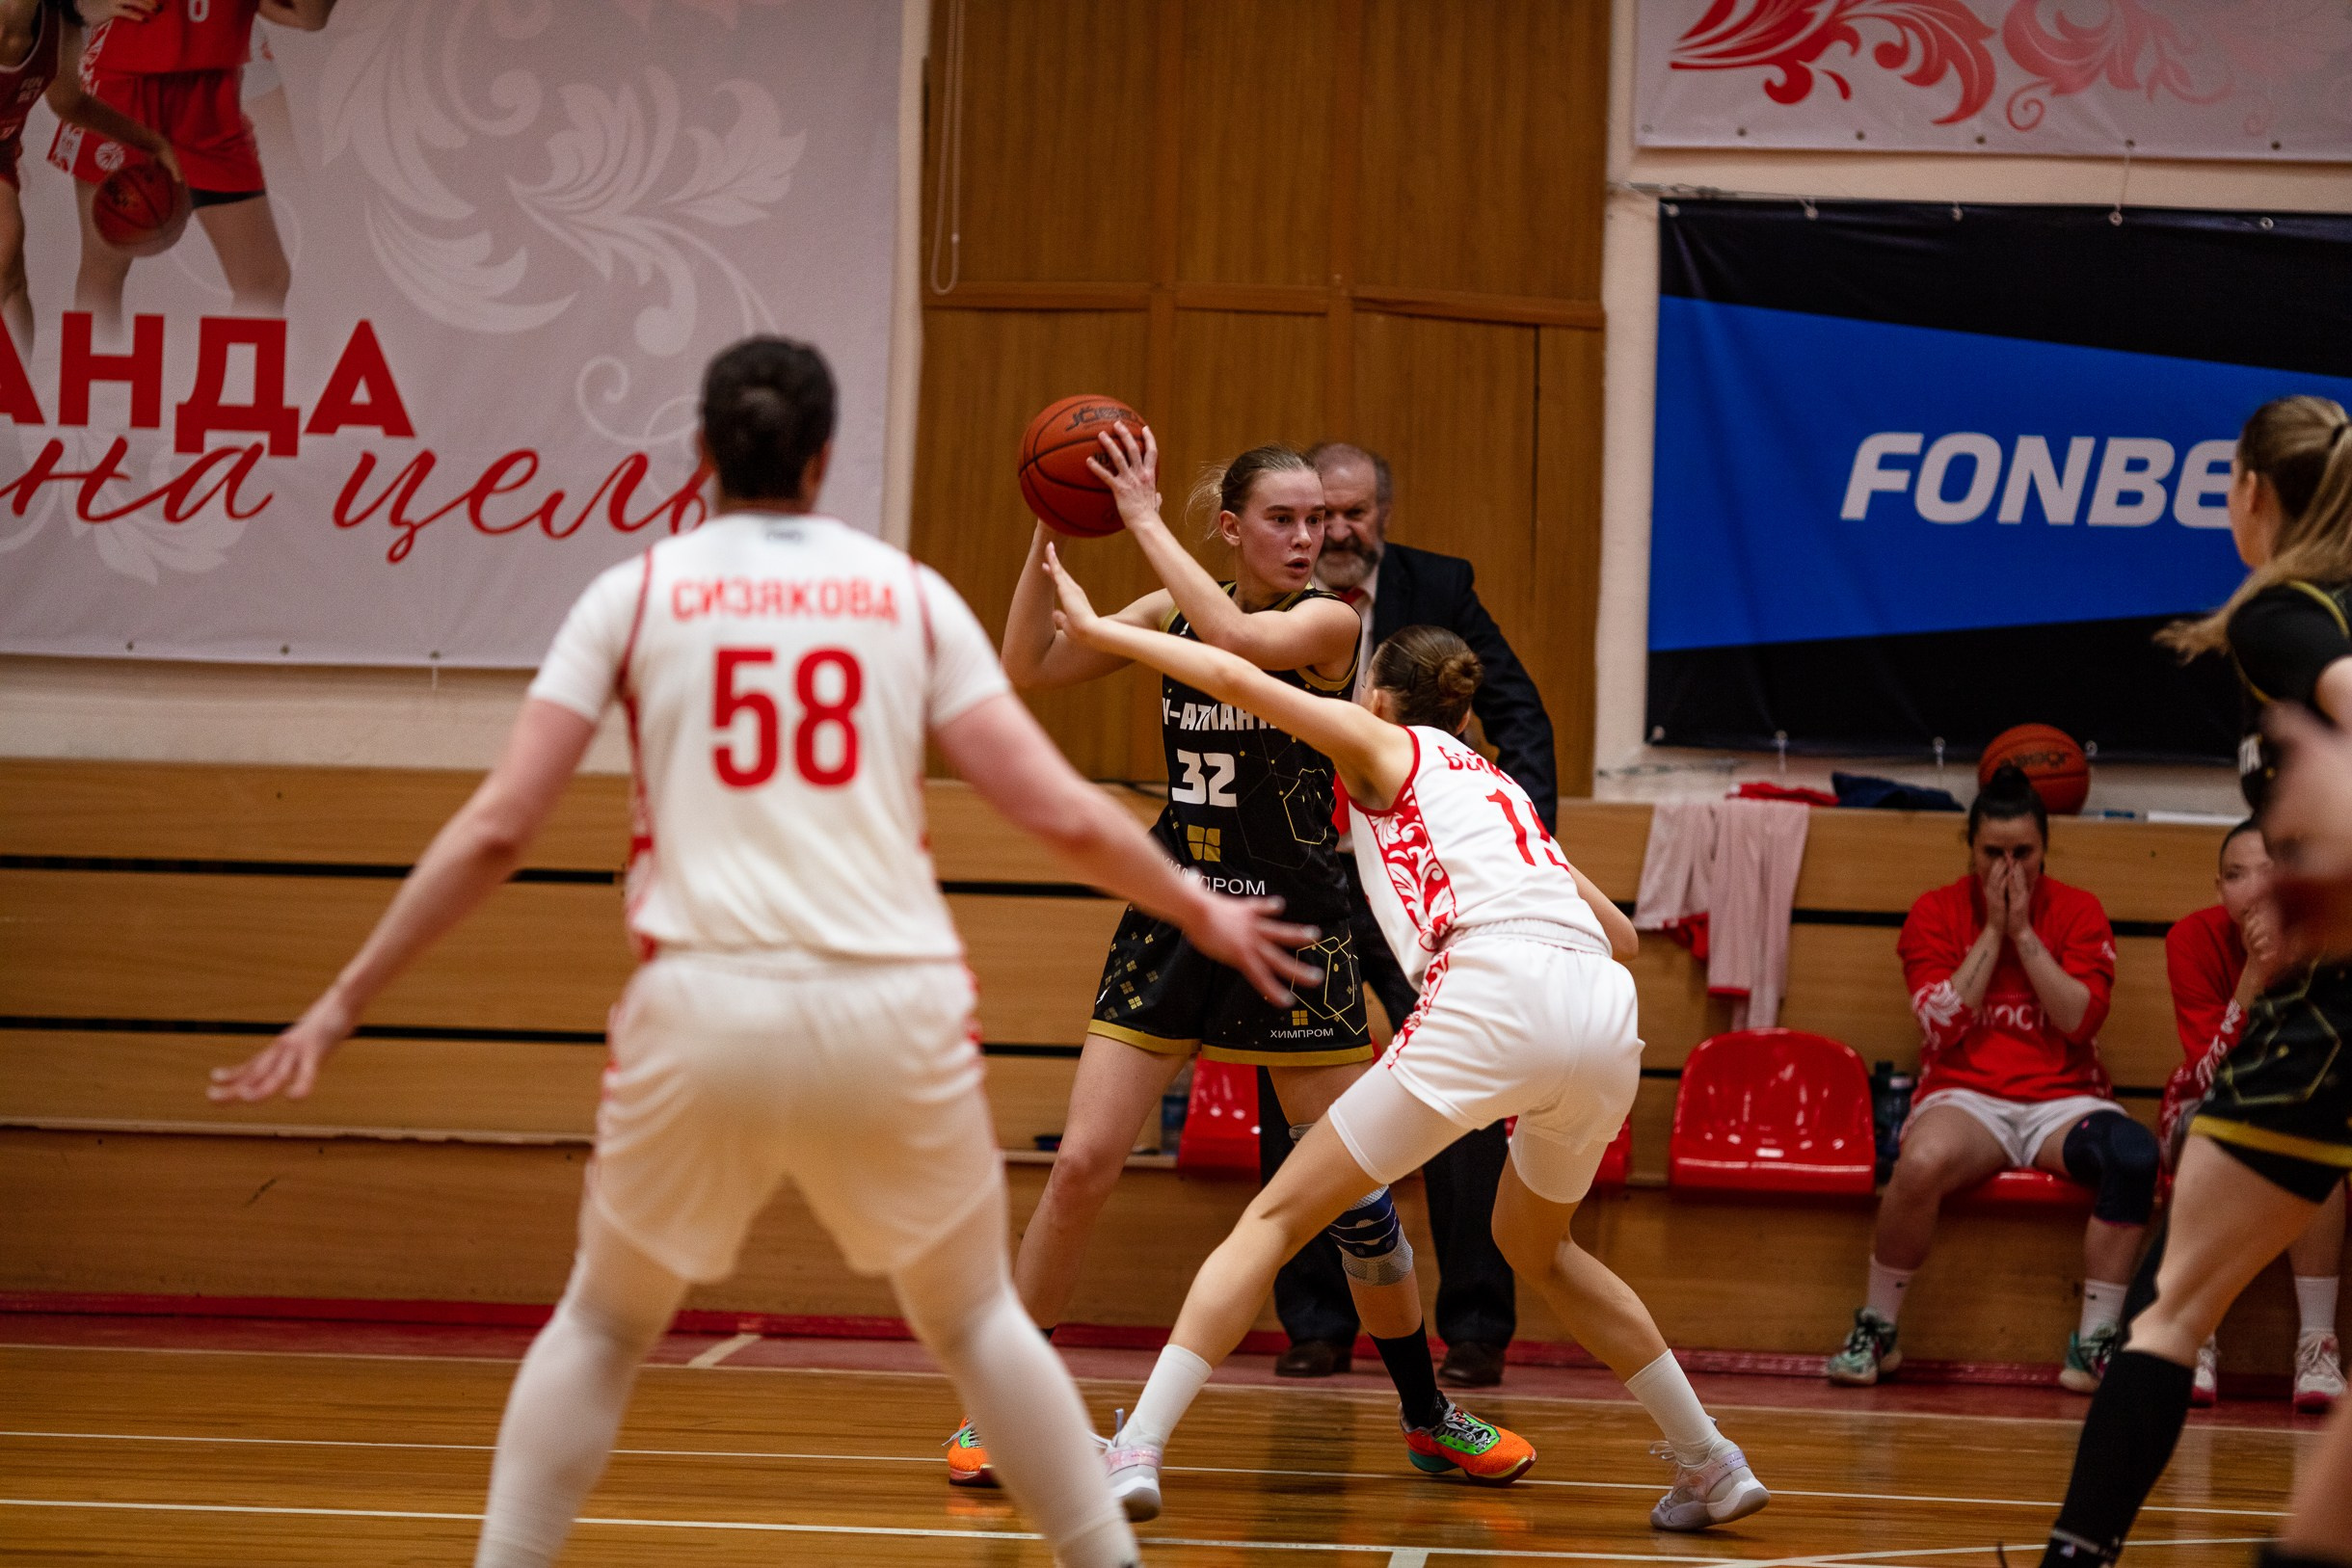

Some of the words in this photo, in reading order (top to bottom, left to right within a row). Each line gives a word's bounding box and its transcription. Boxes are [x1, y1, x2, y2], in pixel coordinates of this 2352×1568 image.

[672, 577, 900, 625] СИЗЯКОВА
[714, 644, 863, 789] 58
[1163, 697, 1278, 731] У-АТЛАН
[1171, 748, 1238, 808] 32
[1270, 1027, 1334, 1039] ХИМПРОМ
